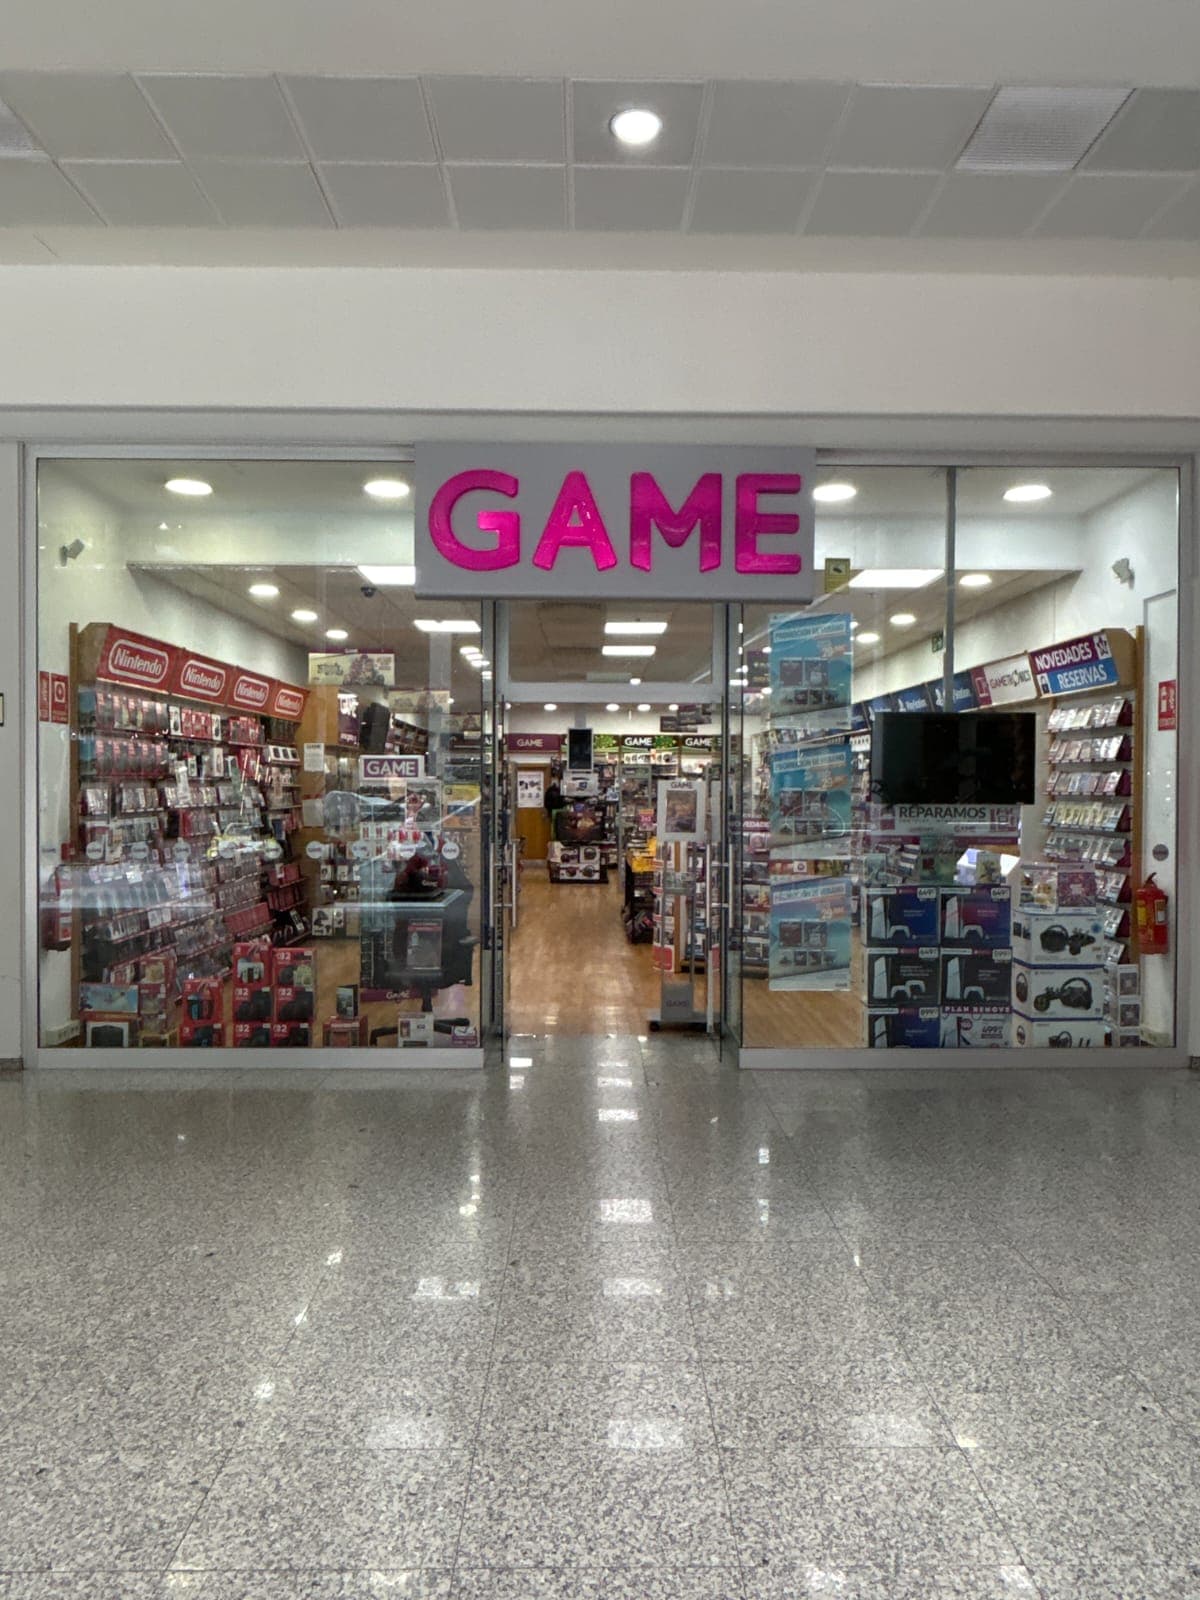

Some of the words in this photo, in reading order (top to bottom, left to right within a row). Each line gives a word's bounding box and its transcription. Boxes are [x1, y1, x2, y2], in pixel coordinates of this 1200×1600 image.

[428, 469, 801, 574] GAME
[114, 649, 163, 676] Nintendo
[1035, 642, 1092, 671] NOVEDADES
[186, 667, 221, 689] Nintendo
[1057, 664, 1108, 689] RESERVAS
[237, 682, 266, 702] Nintendo
[517, 738, 544, 748] GAME
[624, 737, 653, 747] GAME
[685, 737, 712, 747] GAME
[367, 760, 417, 776] GAME
[671, 781, 693, 789] GAME
[900, 806, 987, 819] REPARAMOS
